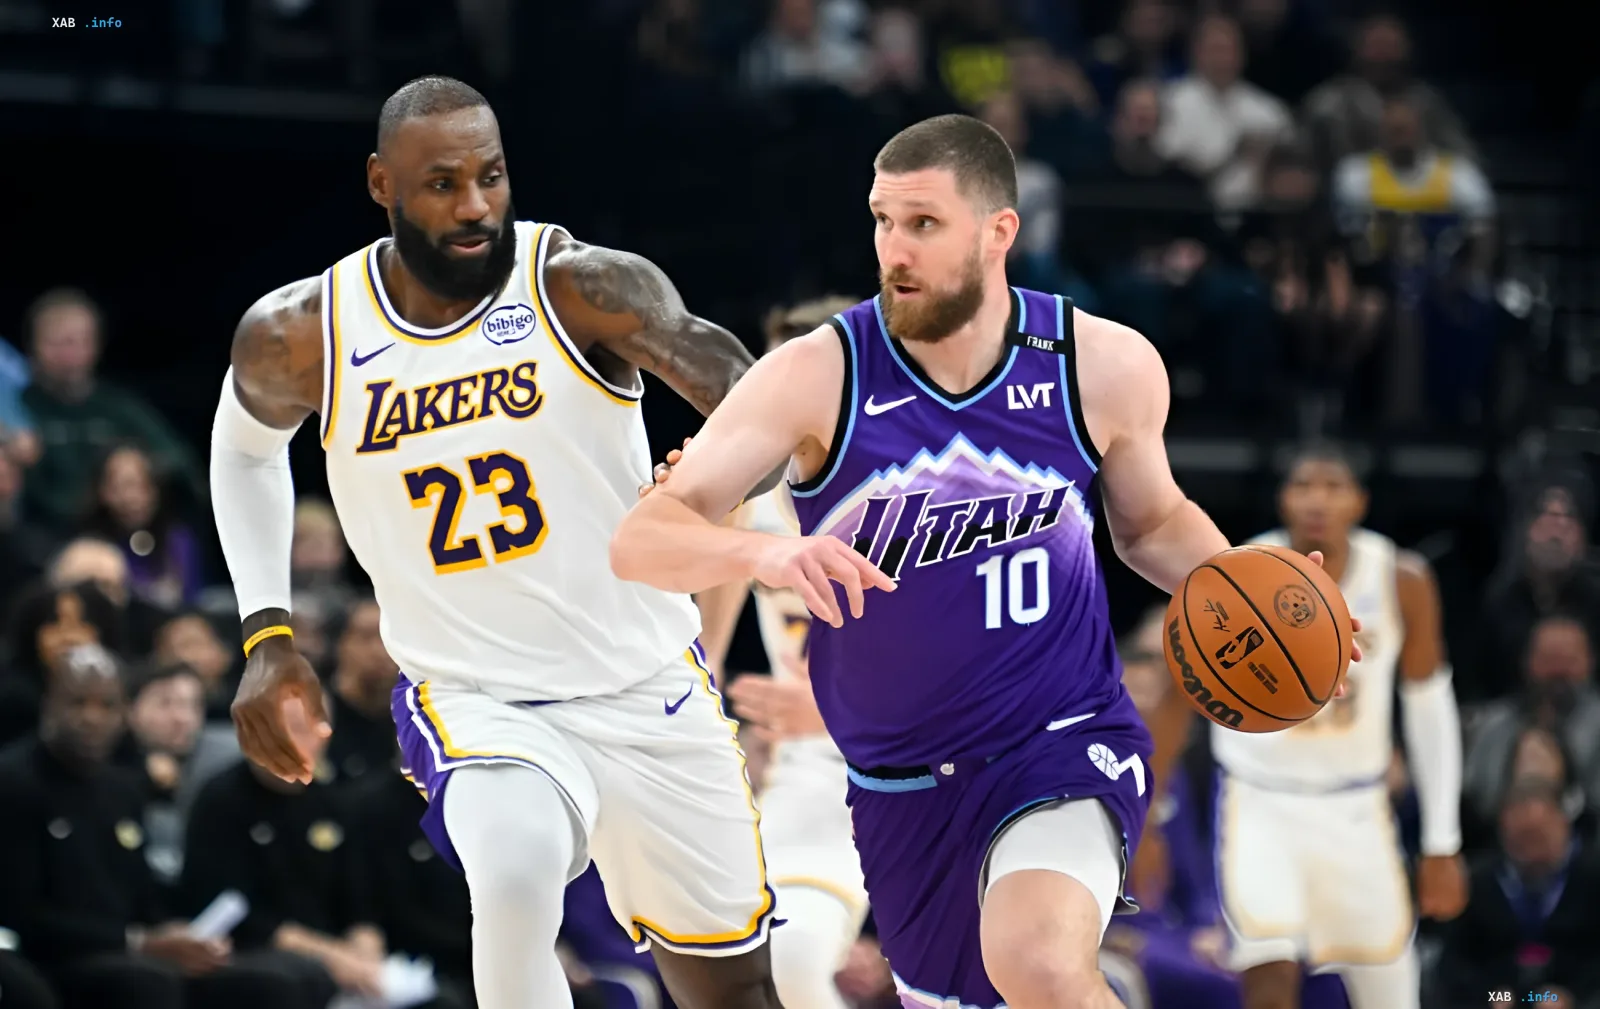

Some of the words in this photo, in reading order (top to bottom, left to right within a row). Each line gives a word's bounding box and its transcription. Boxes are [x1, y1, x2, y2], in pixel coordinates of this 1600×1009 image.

[486, 314, 533, 333] bibigo
[355, 360, 545, 454] LAKERS
[1006, 382, 1055, 410] LVT
[400, 449, 549, 575] 23
[851, 480, 1076, 581] UTAH
[975, 546, 1050, 630] 10
[1168, 615, 1244, 727] Wilson
